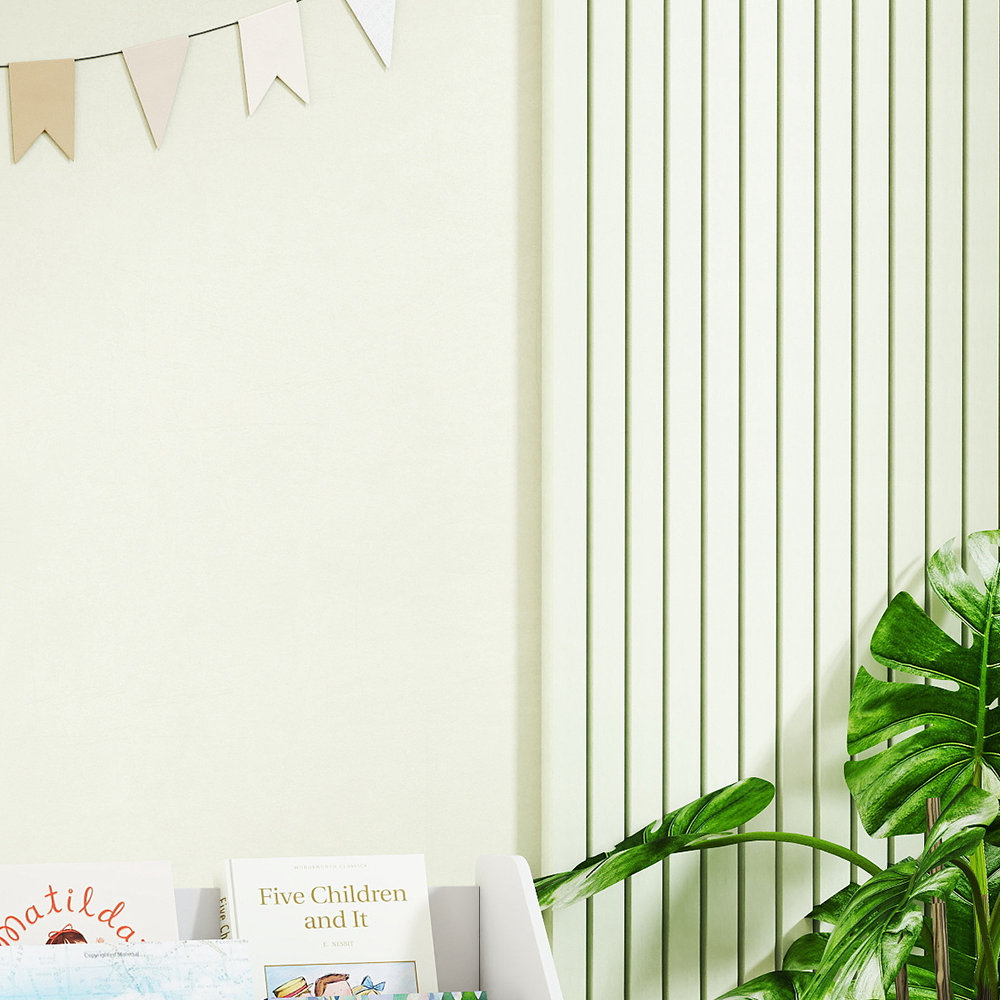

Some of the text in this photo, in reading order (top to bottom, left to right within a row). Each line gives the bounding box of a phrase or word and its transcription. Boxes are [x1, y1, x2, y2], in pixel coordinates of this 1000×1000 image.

[259, 885, 408, 905] Five Children
[304, 910, 368, 929] and It
